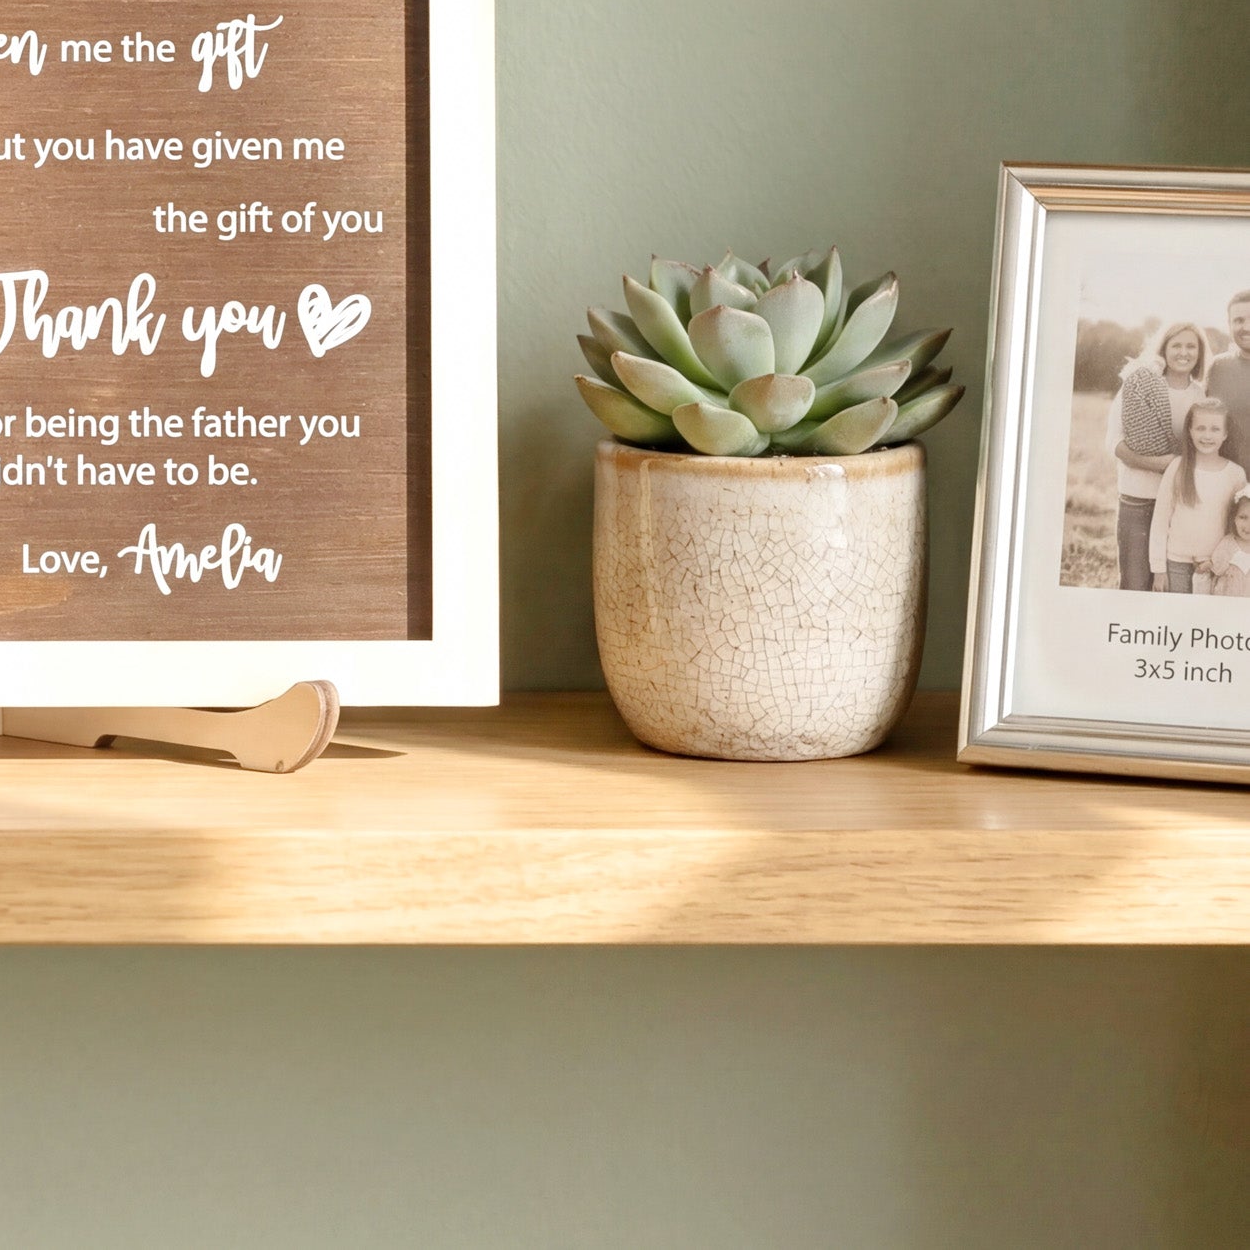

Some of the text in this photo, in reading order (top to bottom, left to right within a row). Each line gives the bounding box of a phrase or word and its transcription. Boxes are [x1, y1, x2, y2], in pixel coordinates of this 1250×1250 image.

[60, 39, 113, 63] me
[120, 31, 176, 63] the
[191, 13, 284, 93] gift
[33, 137, 95, 169] you
[105, 129, 184, 161] have
[191, 129, 283, 169] given
[293, 137, 345, 161] me
[152, 201, 384, 241] the gift of you
[181, 300, 287, 378] you
[25, 406, 120, 446] being
[128, 406, 184, 438] the
[191, 405, 292, 438] father
[298, 414, 361, 446] you
[77, 453, 156, 486] have
[163, 458, 199, 486] to
[208, 454, 258, 486] be.
[22, 522, 283, 596] Love, Amelia
[1108, 623, 1183, 652] Family
[1134, 658, 1232, 683] 3x5 inch
